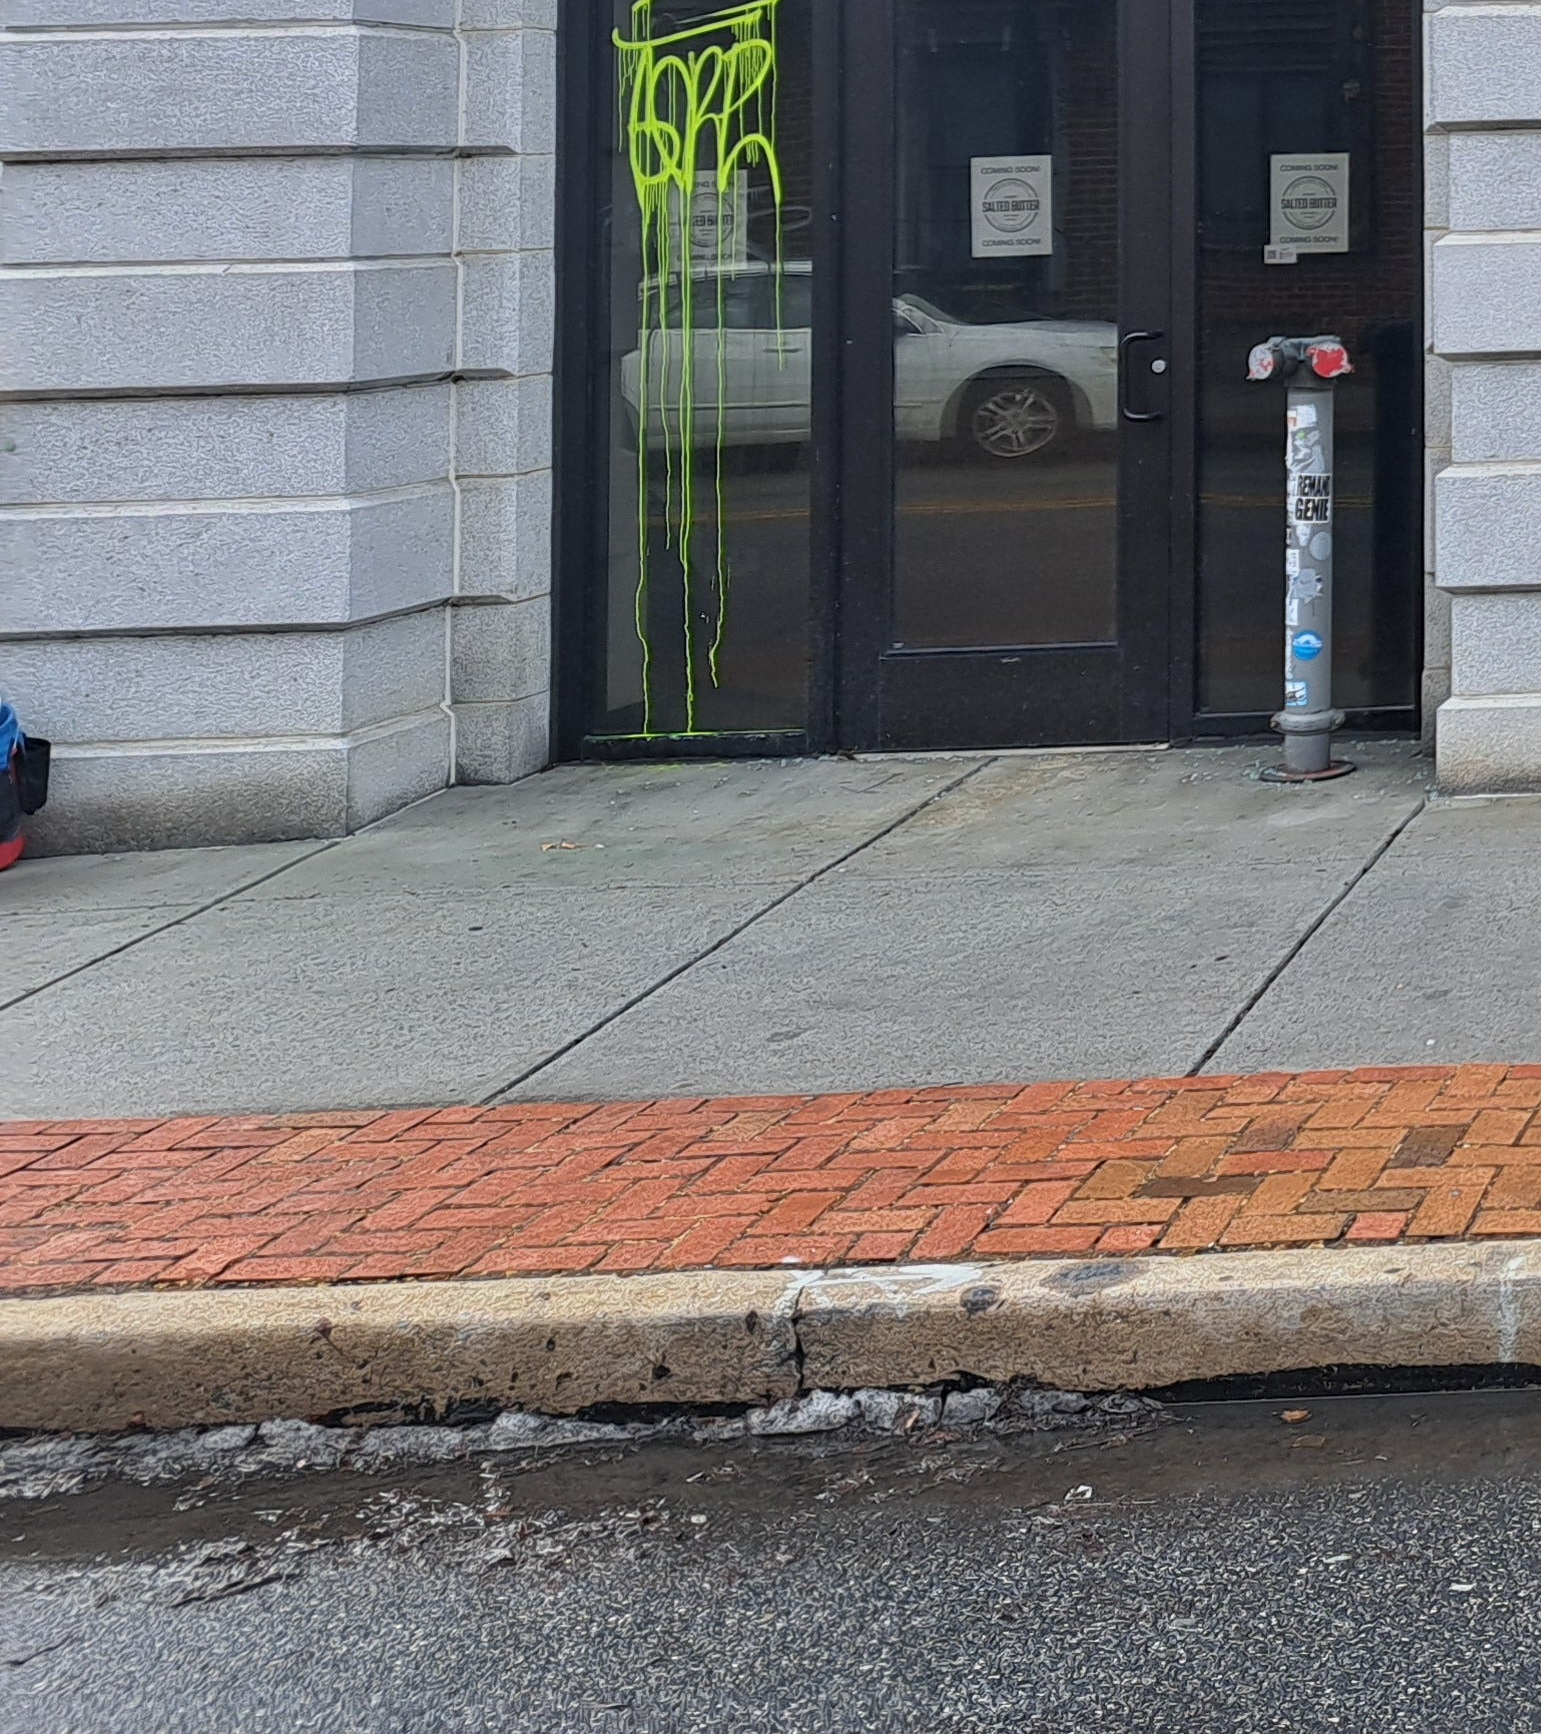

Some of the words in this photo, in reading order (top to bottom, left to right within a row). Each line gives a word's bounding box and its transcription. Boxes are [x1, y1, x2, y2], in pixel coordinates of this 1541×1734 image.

[981, 201, 1010, 212] SALTED
[1011, 200, 1040, 211] BUTTER
[1281, 198, 1308, 209] SALTED
[1309, 197, 1337, 209] BUTTER
